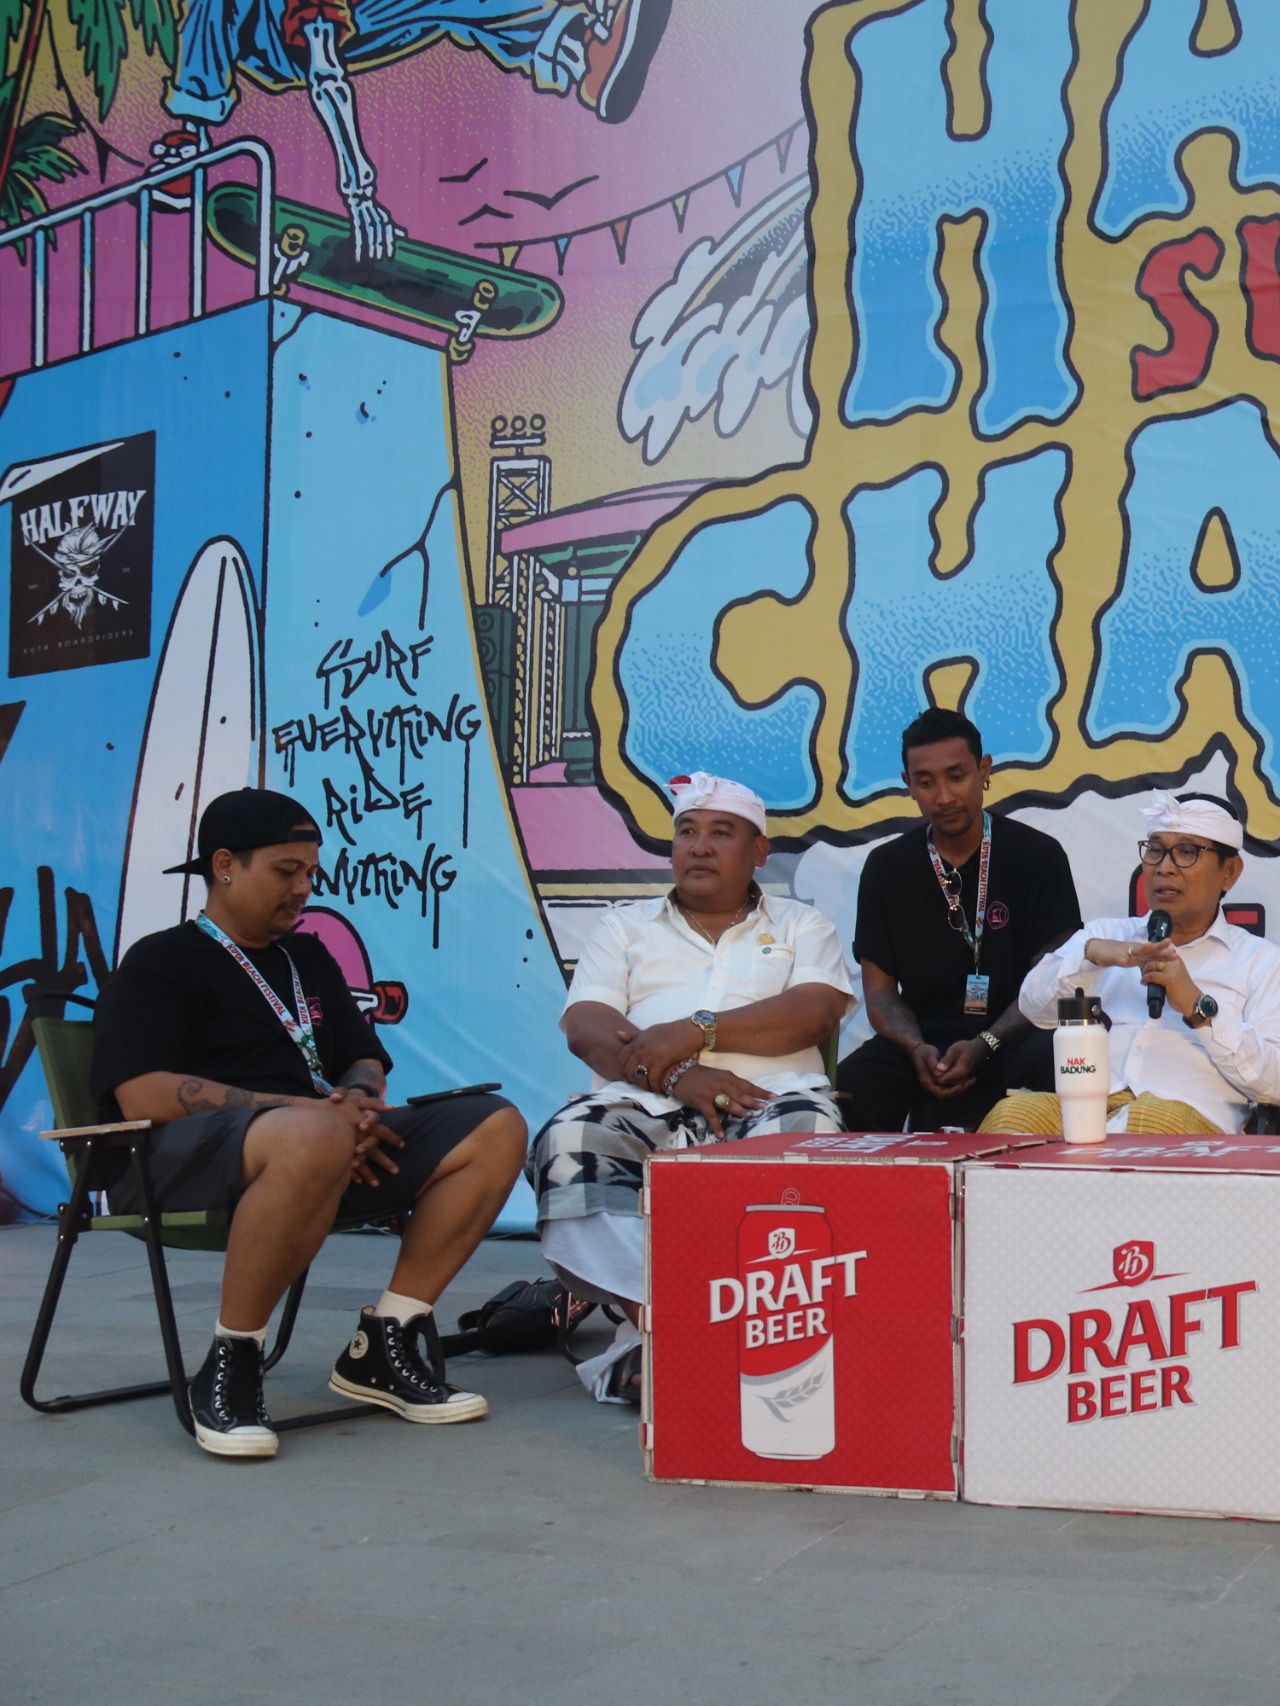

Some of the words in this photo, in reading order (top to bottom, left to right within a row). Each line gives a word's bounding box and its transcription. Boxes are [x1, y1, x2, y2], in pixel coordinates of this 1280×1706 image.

[20, 490, 147, 546] HALFWAY
[23, 645, 50, 655] KUTA
[57, 629, 135, 649] BOARDRIDERS
[316, 629, 434, 709] SURF
[981, 840, 990, 860] KUTA
[311, 843, 457, 918] NYTHING
[979, 860, 989, 883] BEACH
[978, 883, 987, 912] FESTIVAL
[226, 943, 245, 963] KUTA
[242, 961, 264, 986] BEACH
[260, 983, 287, 1017] FESTIVAL
[299, 1006, 310, 1025] KUTA
[1060, 1065, 1096, 1074] BADUNG
[1067, 1057, 1086, 1066] NAK
[708, 1250, 867, 1323] DRAFT
[745, 1307, 828, 1349] BEER
[1011, 1280, 1258, 1385] DRAFT
[1067, 1365, 1196, 1424] BEER
